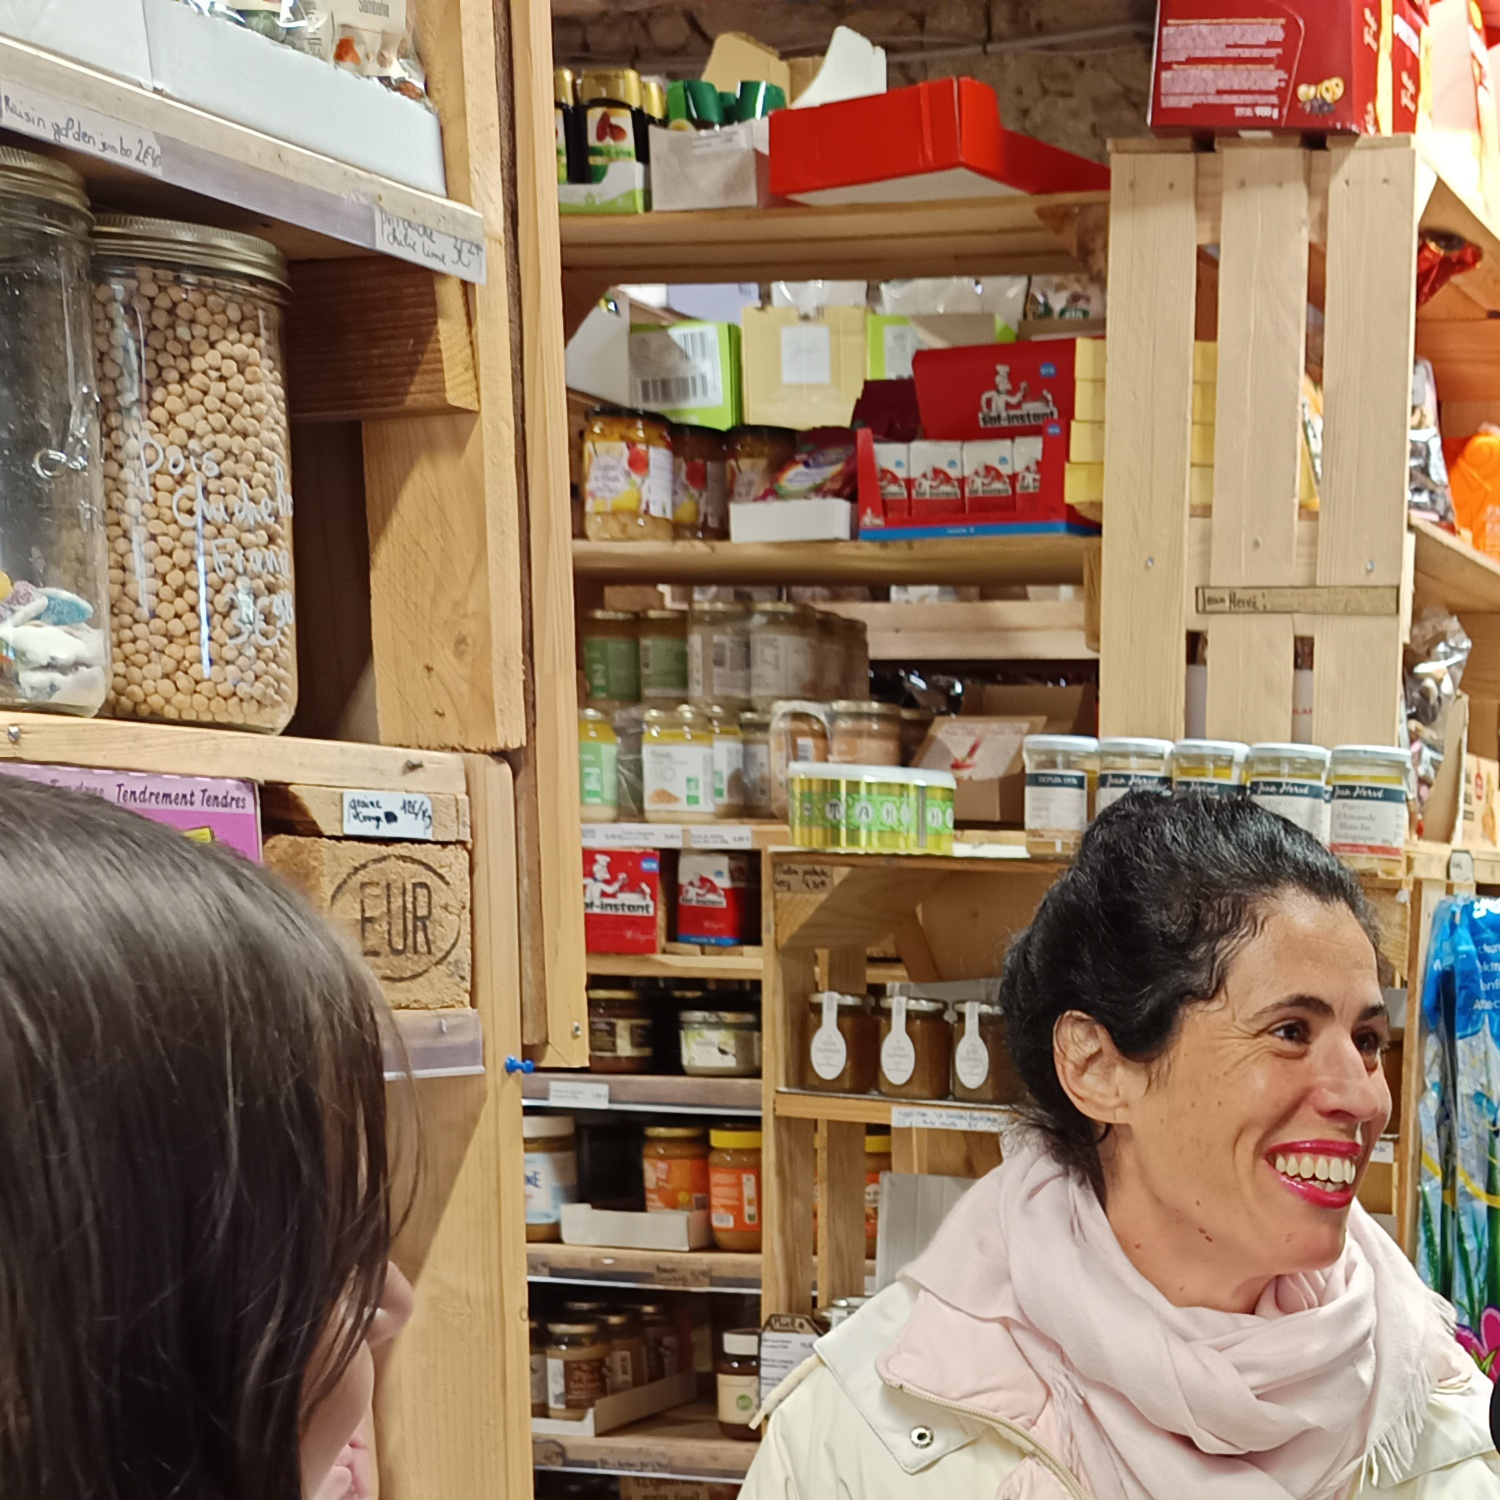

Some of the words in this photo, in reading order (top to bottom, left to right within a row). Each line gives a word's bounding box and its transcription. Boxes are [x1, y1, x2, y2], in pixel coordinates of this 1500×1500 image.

[116, 782, 196, 806] Tendrement
[200, 788, 247, 810] Tendres
[359, 881, 433, 957] EUR
[584, 900, 651, 914] af-instant
